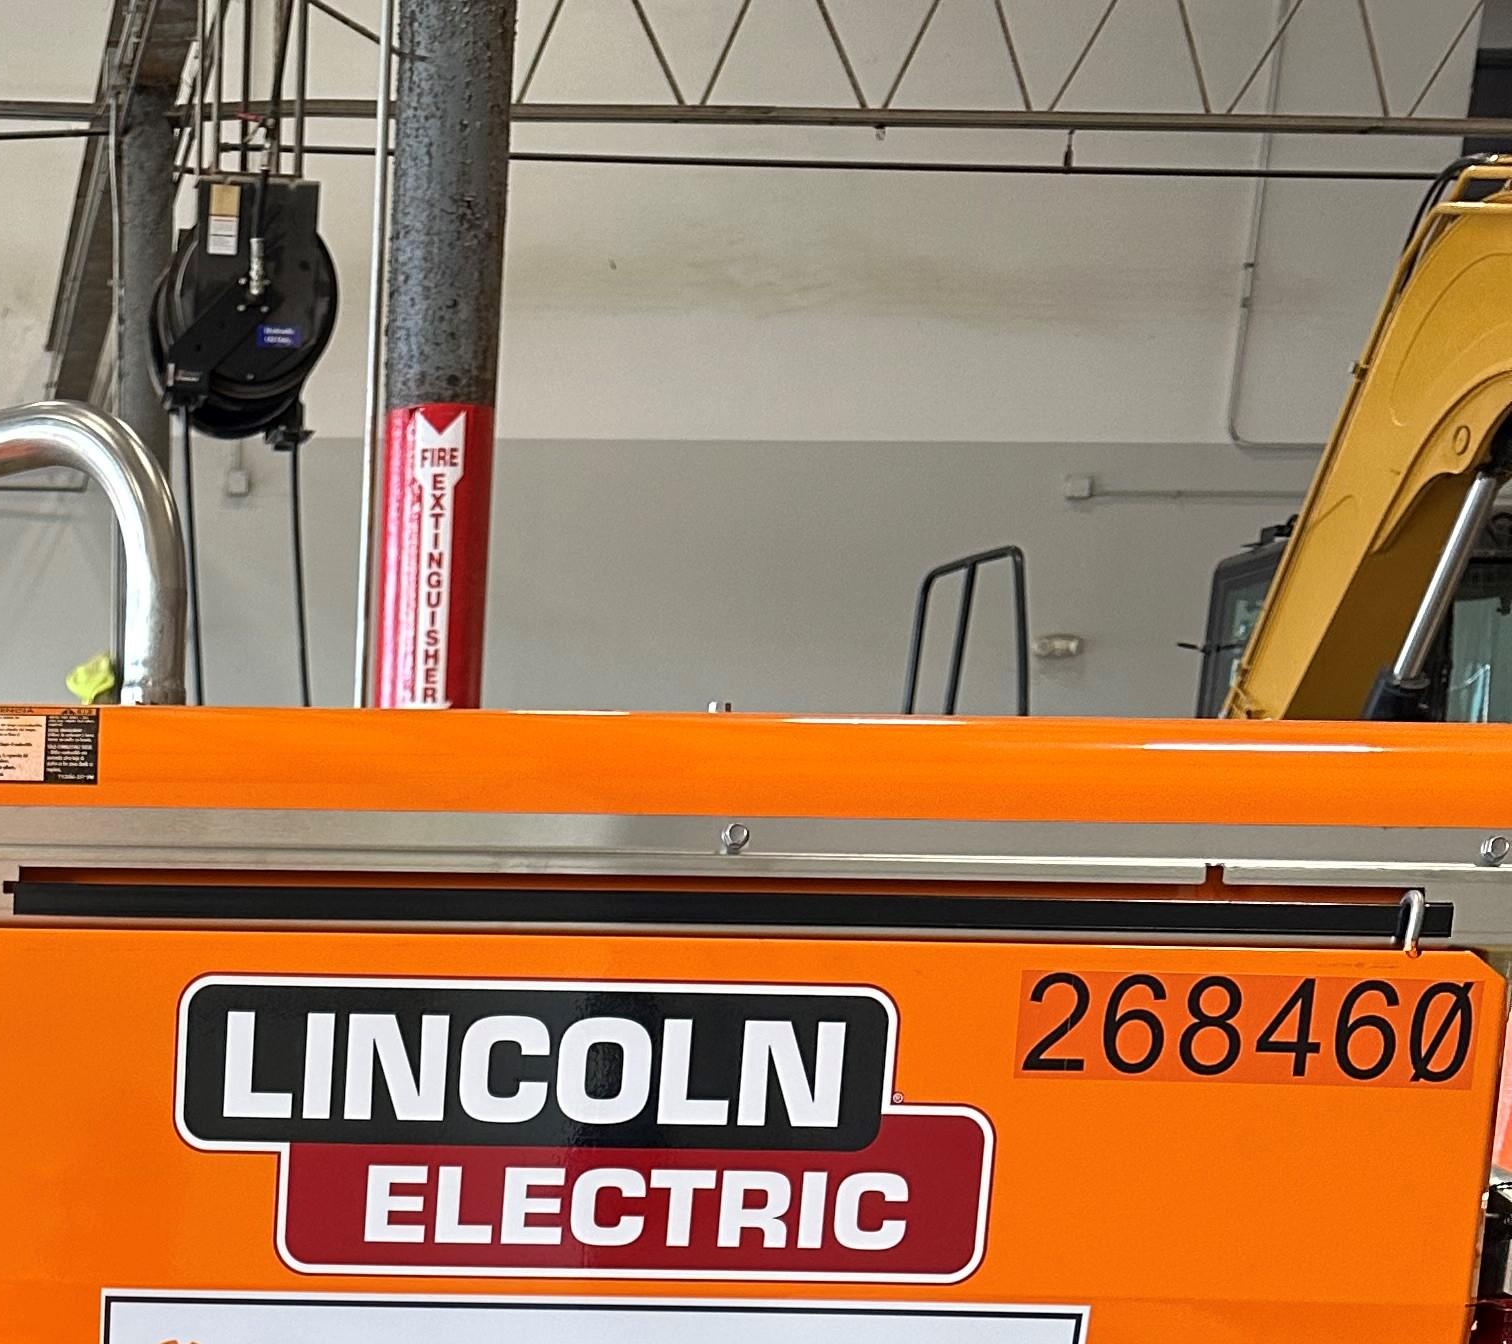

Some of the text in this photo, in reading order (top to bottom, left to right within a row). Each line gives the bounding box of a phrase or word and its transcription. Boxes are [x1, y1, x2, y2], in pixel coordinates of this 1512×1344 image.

[420, 447, 459, 467] FIRE
[424, 473, 447, 704] EXTINGUISHER
[223, 1011, 847, 1127] LINCOLN
[1022, 970, 1474, 1084] 268460
[364, 1165, 910, 1252] ELECTRIC
